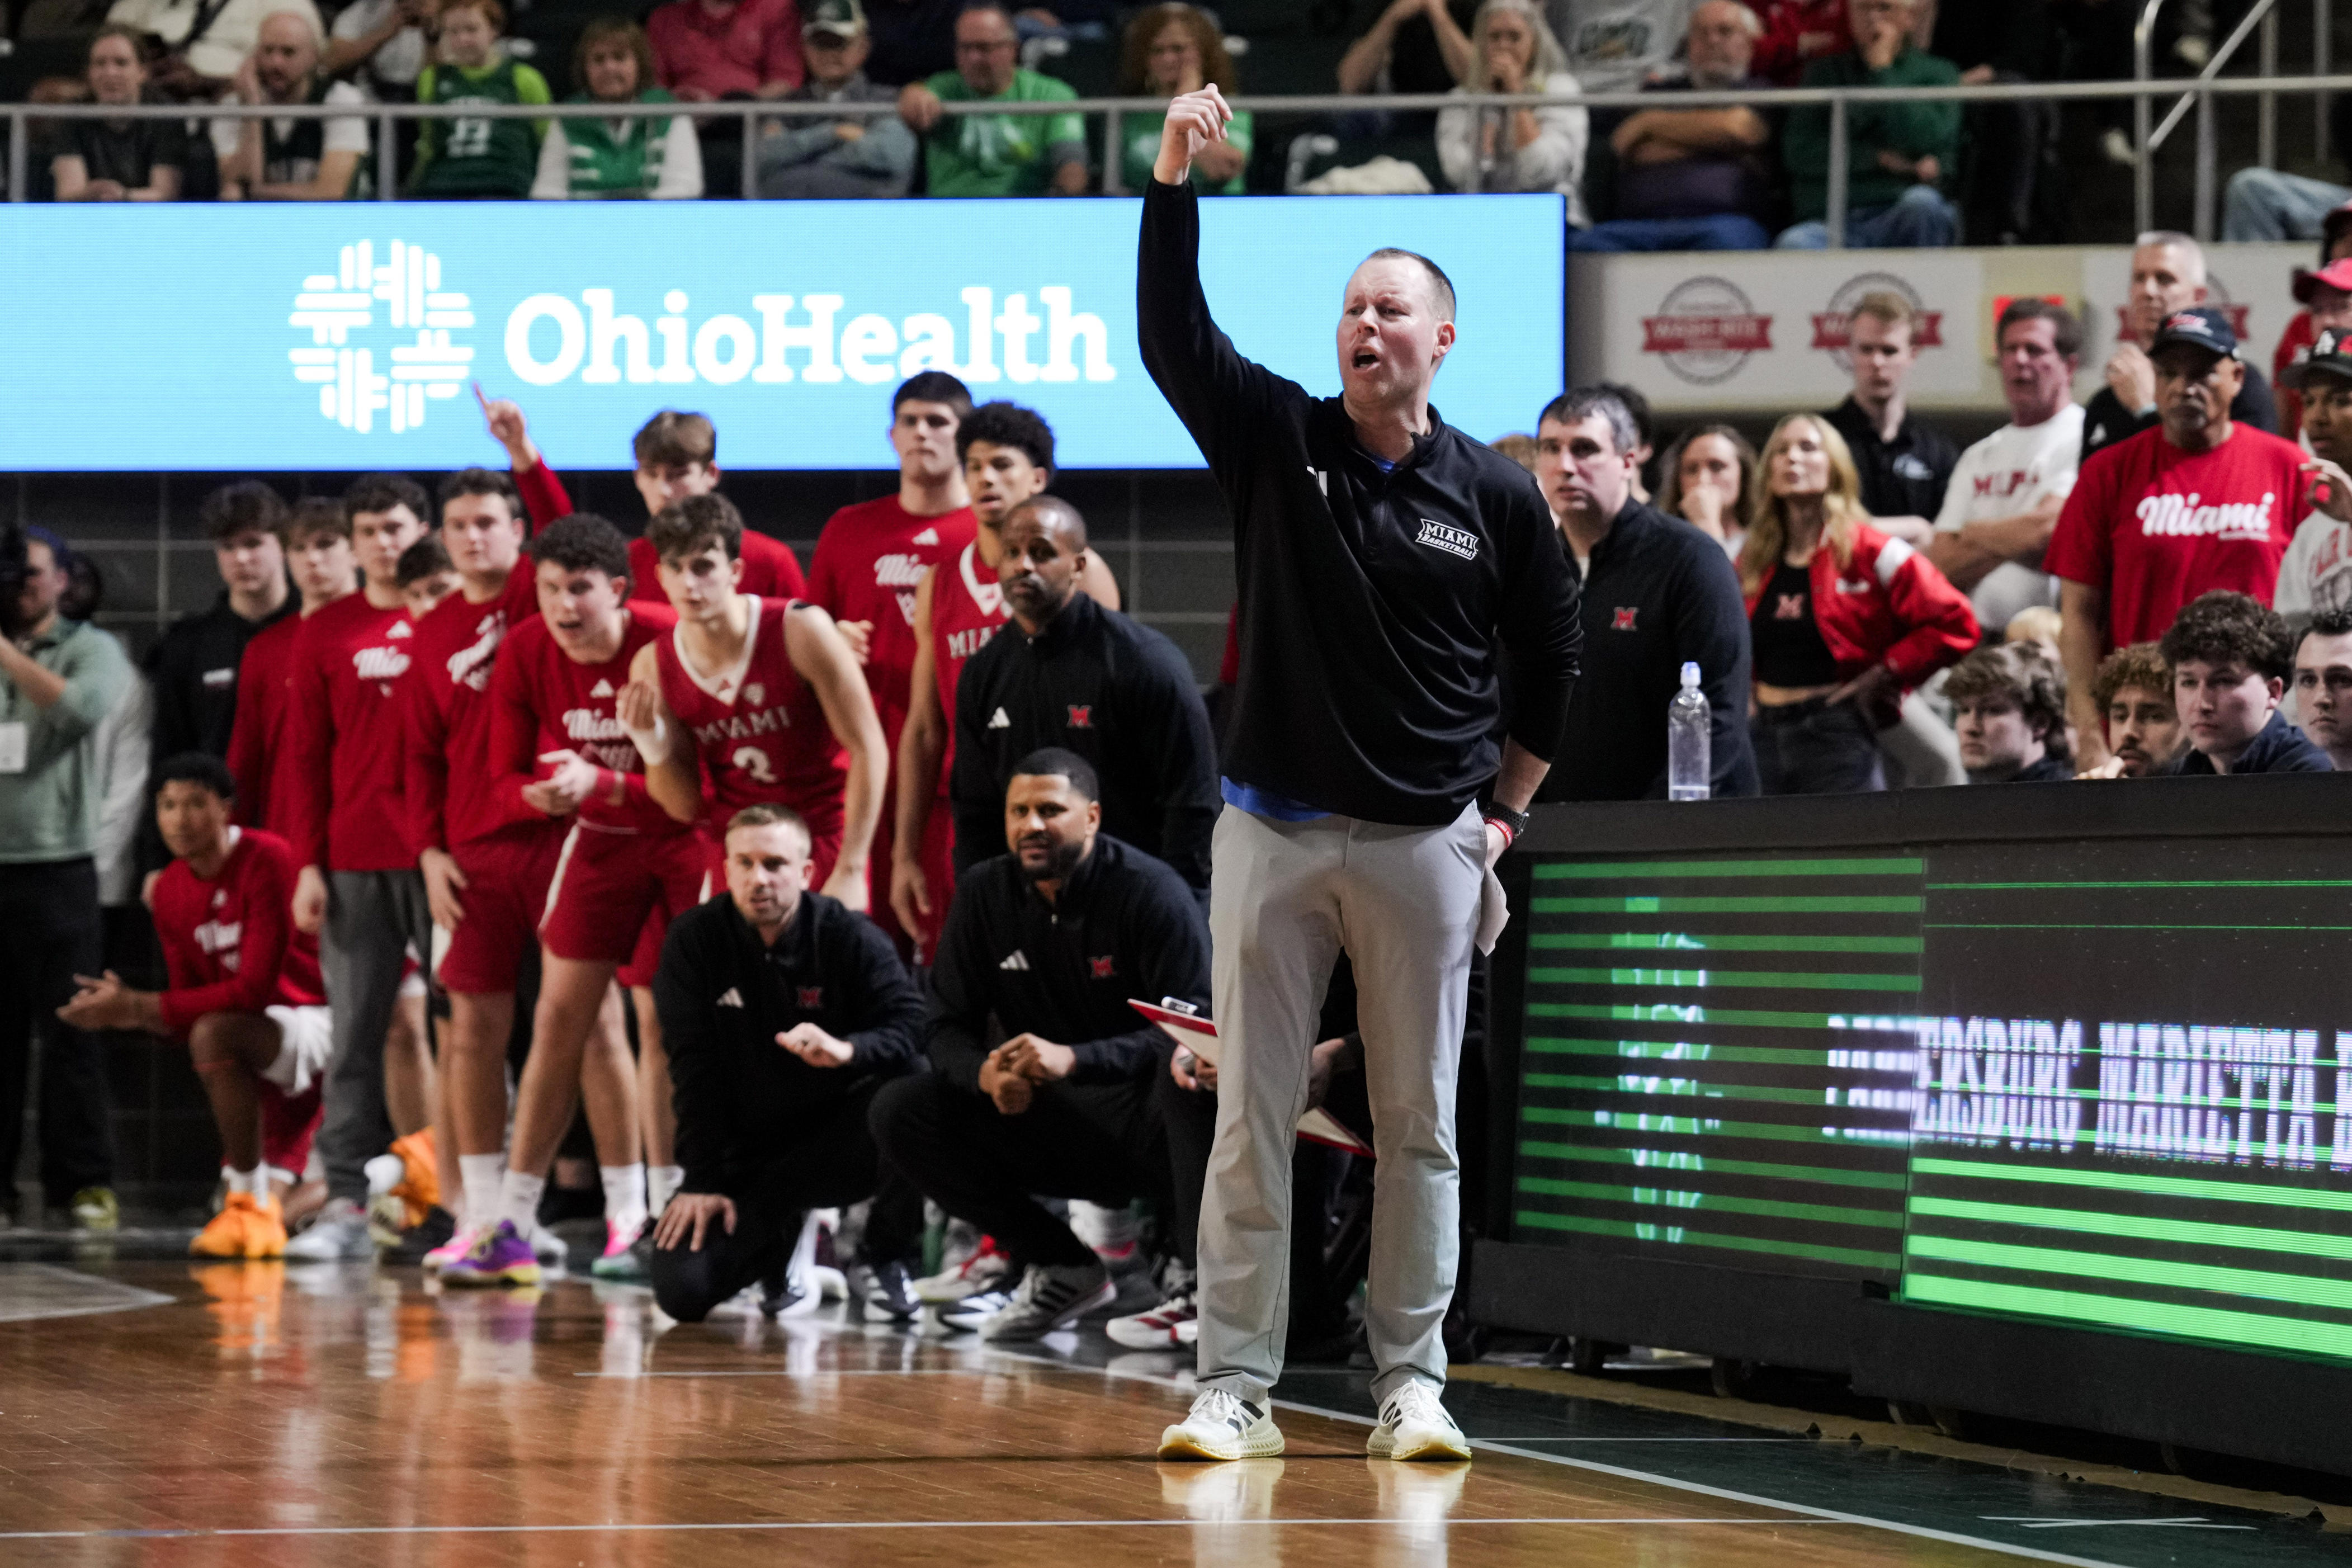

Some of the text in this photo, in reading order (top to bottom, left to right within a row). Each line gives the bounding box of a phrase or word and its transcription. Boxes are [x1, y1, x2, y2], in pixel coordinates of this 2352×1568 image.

[504, 286, 1116, 384] OhioHealth
[2136, 492, 2275, 536] Miami
[1420, 533, 1473, 557] BASKETBALL
[1424, 522, 1475, 550] MIAMI
[874, 554, 928, 585] Mia
[1610, 607, 1639, 631] M
[947, 624, 1003, 659] MIA
[353, 645, 412, 680] Mia
[562, 708, 625, 740] Mia
[693, 706, 790, 744] MIAMI
[1066, 705, 1094, 729] M
[2095, 1022, 2318, 1170] MARIETTA
